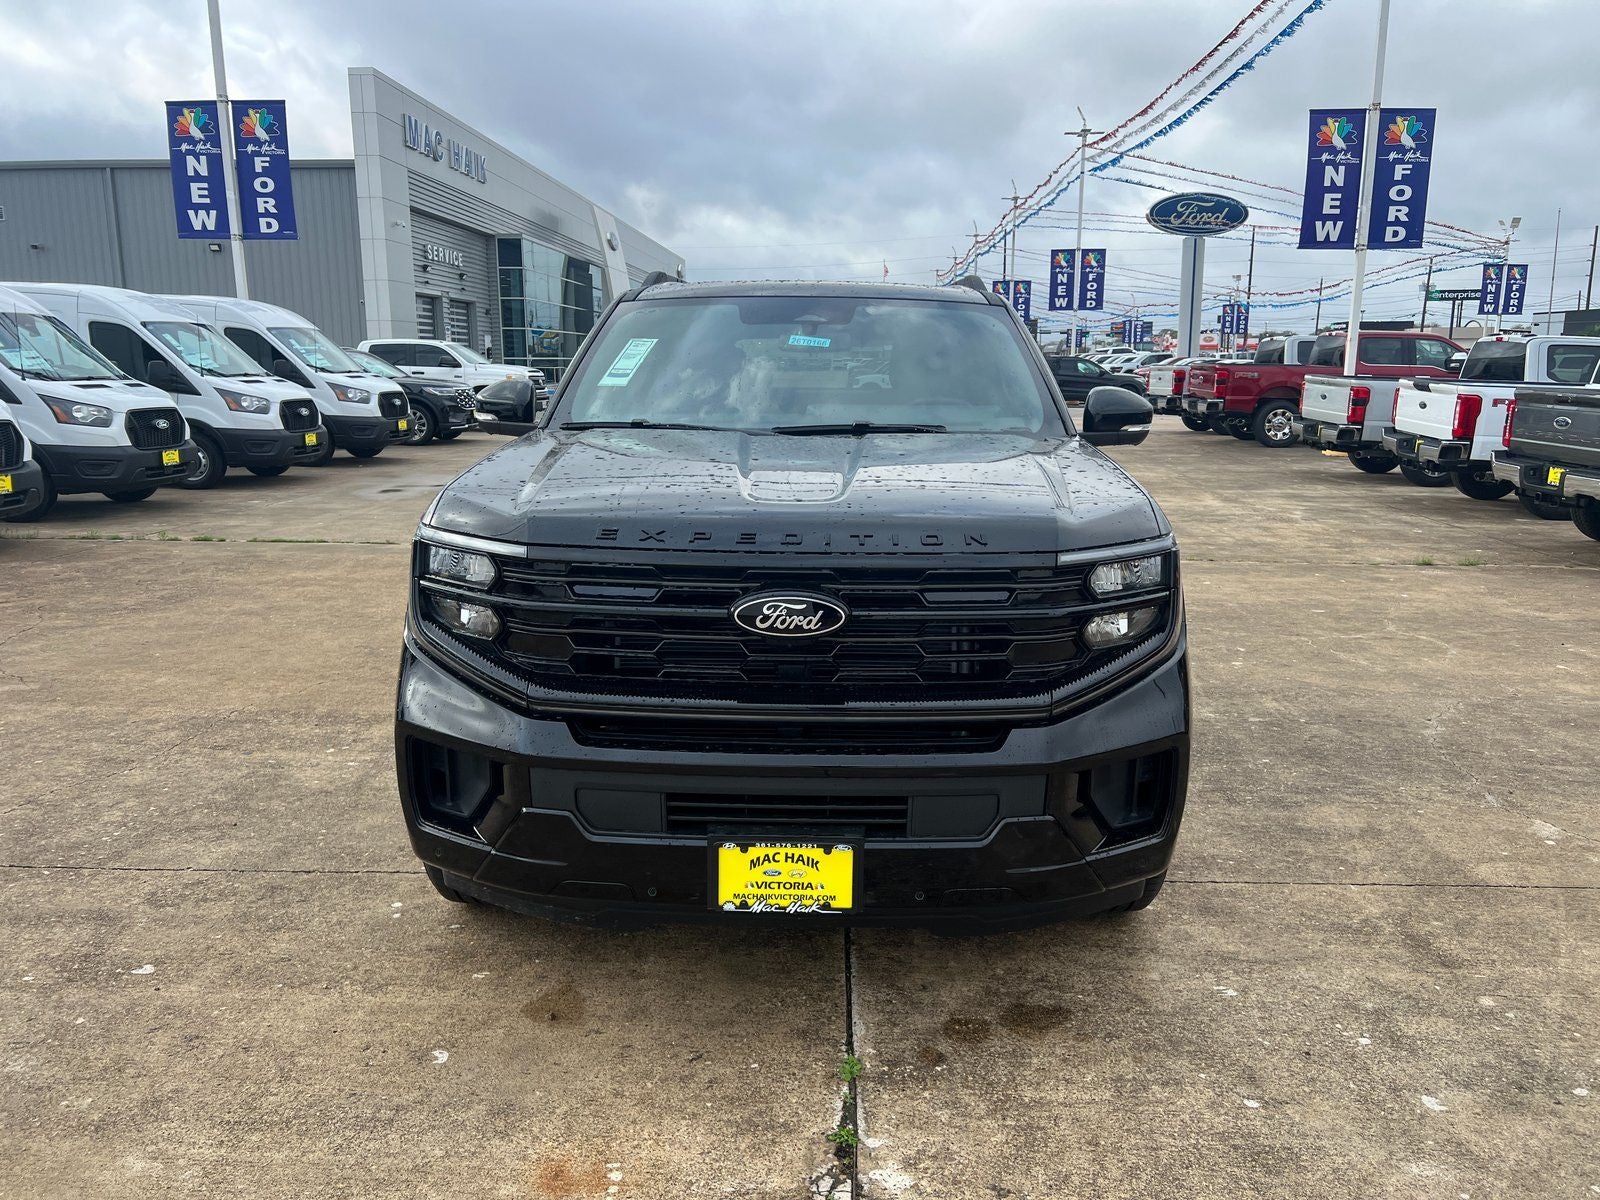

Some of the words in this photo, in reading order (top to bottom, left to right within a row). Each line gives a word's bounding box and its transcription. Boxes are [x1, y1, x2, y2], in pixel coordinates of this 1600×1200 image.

[404, 113, 444, 161] MAC
[449, 139, 487, 184] HAIK
[186, 156, 217, 230] NEW
[253, 157, 279, 234] FORD
[1315, 166, 1345, 241] NEW
[1384, 164, 1413, 242] FORD
[1170, 201, 1229, 226] Ford
[427, 244, 463, 267] SERVICE
[1054, 273, 1068, 308] NEW
[1086, 273, 1097, 308] FORD
[1431, 290, 1481, 300] enterprise
[1484, 284, 1496, 313] NEW
[1508, 284, 1520, 313] FORD
[595, 528, 989, 548] EXPEDITION
[755, 602, 823, 631] Ford
[750, 852, 781, 871] MAC
[784, 852, 820, 872] HAIK
[733, 893, 837, 902] MACHAIKVICTORIA.COM
[755, 881, 814, 891] VICTORIA
[750, 900, 781, 914] Mac
[785, 900, 823, 914] Haik
